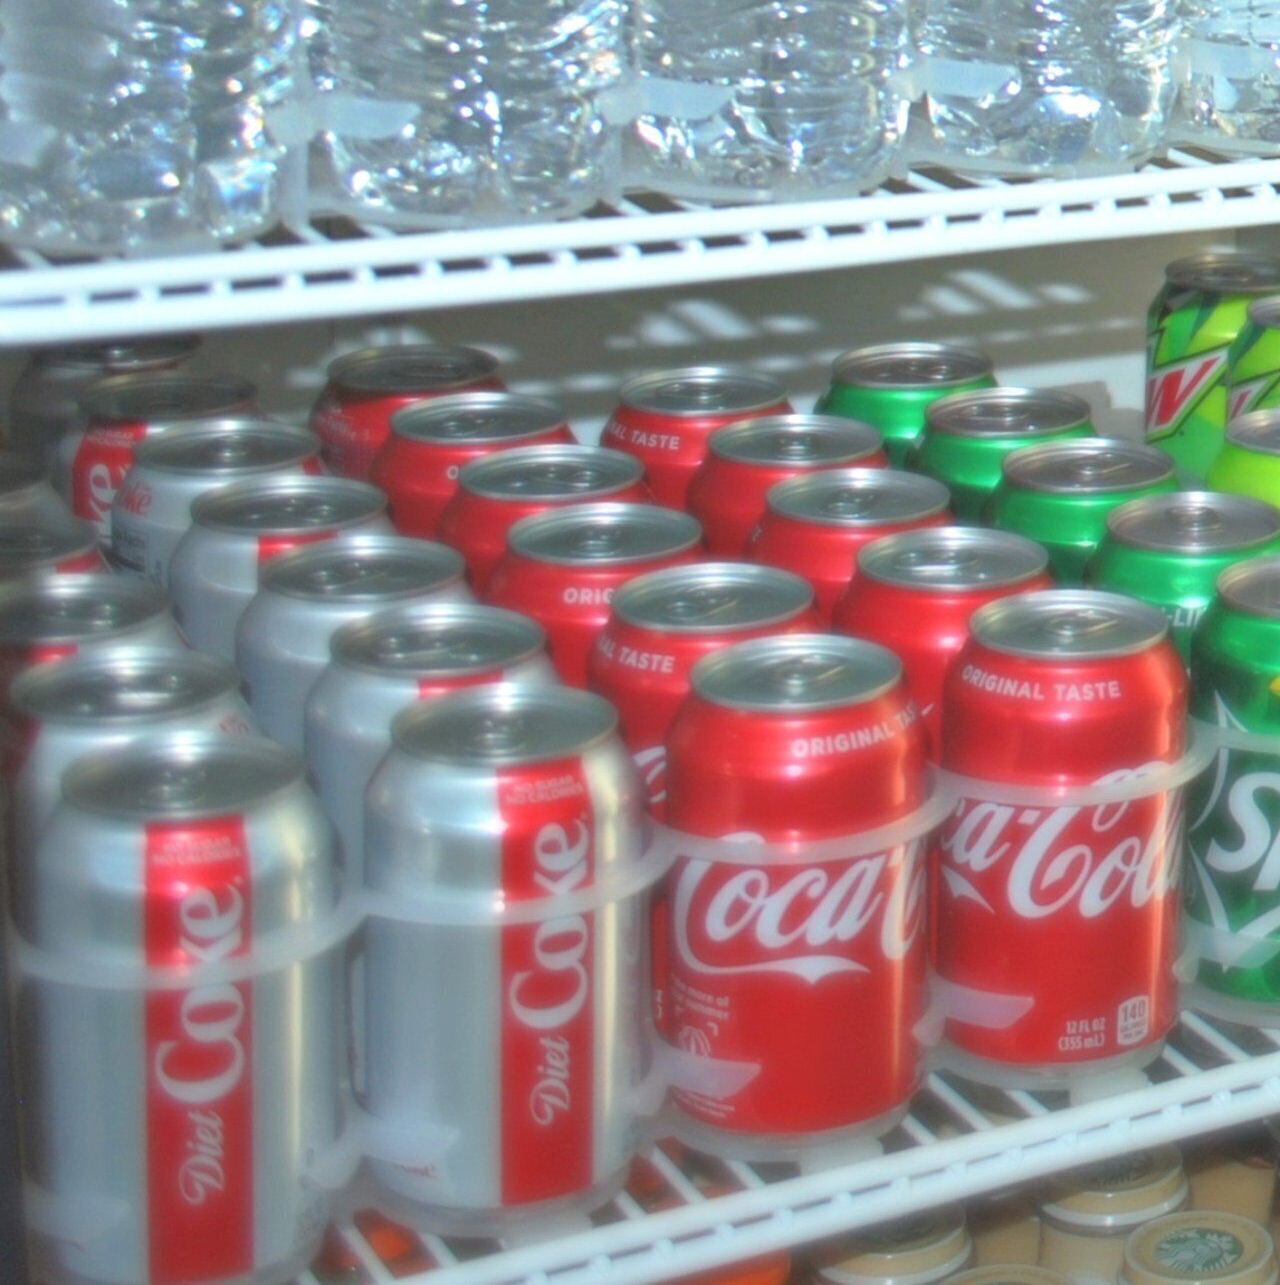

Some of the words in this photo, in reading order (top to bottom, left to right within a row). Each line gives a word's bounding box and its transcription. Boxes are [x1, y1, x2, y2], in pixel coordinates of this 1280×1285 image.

[629, 429, 680, 451] TASTE
[619, 646, 676, 674] TASTE
[962, 665, 1044, 702] ORIGINAL
[1053, 680, 1122, 702] TASTE
[790, 724, 895, 758] ORIGINAL
[508, 820, 590, 1030] Coke
[155, 882, 246, 1105] Coke
[1066, 1020, 1077, 1035] 12
[1122, 1000, 1146, 1023] 140
[1058, 1035, 1082, 1051] (355
[531, 1035, 571, 1127] Diet
[178, 1109, 226, 1205] Diet
